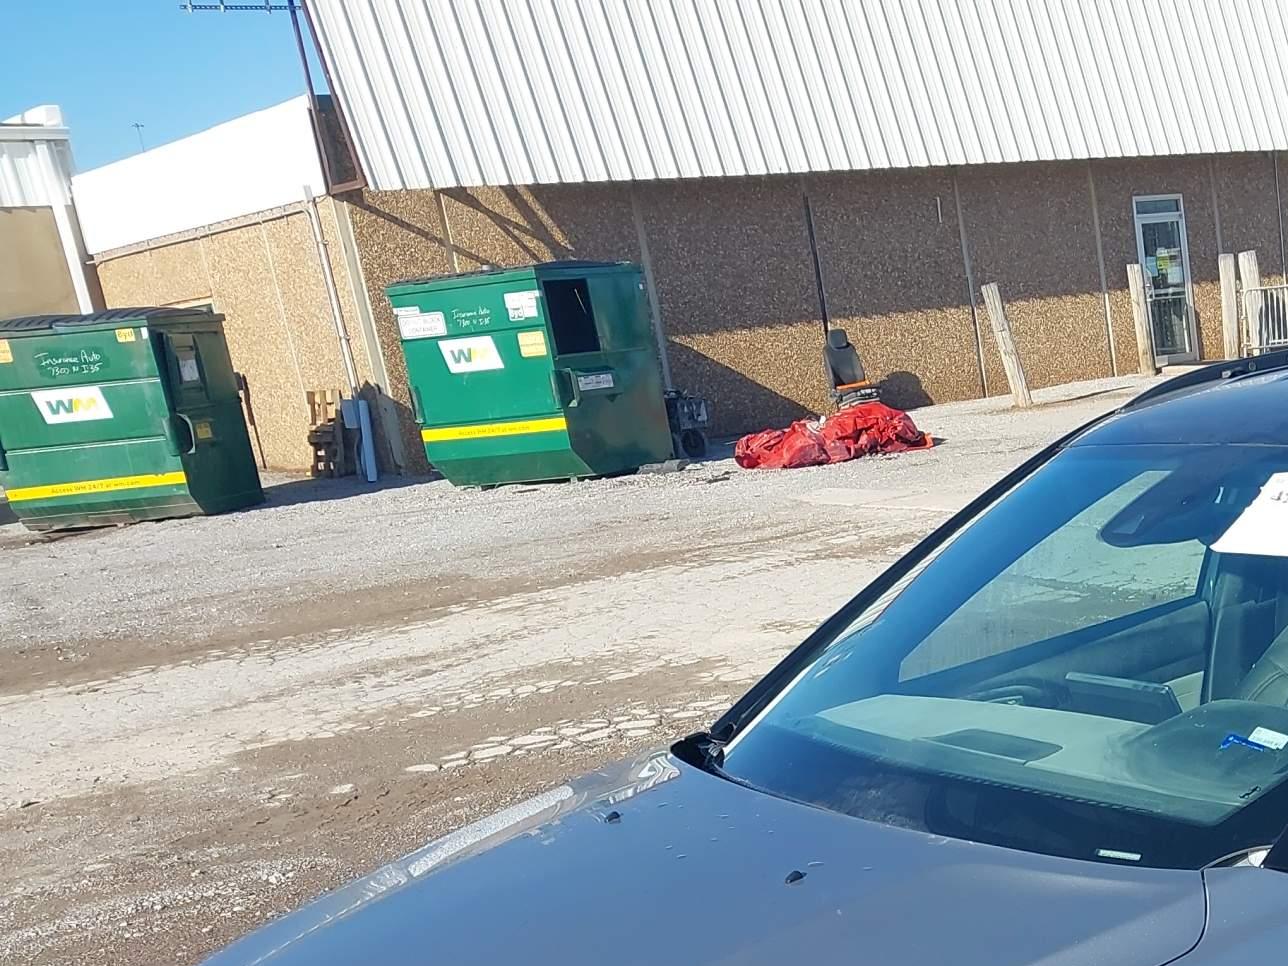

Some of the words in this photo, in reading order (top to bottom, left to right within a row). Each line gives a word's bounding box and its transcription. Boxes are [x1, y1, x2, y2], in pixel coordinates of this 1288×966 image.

[34, 353, 79, 366] Insurance
[80, 349, 101, 363] Auto
[45, 397, 97, 416] WM
